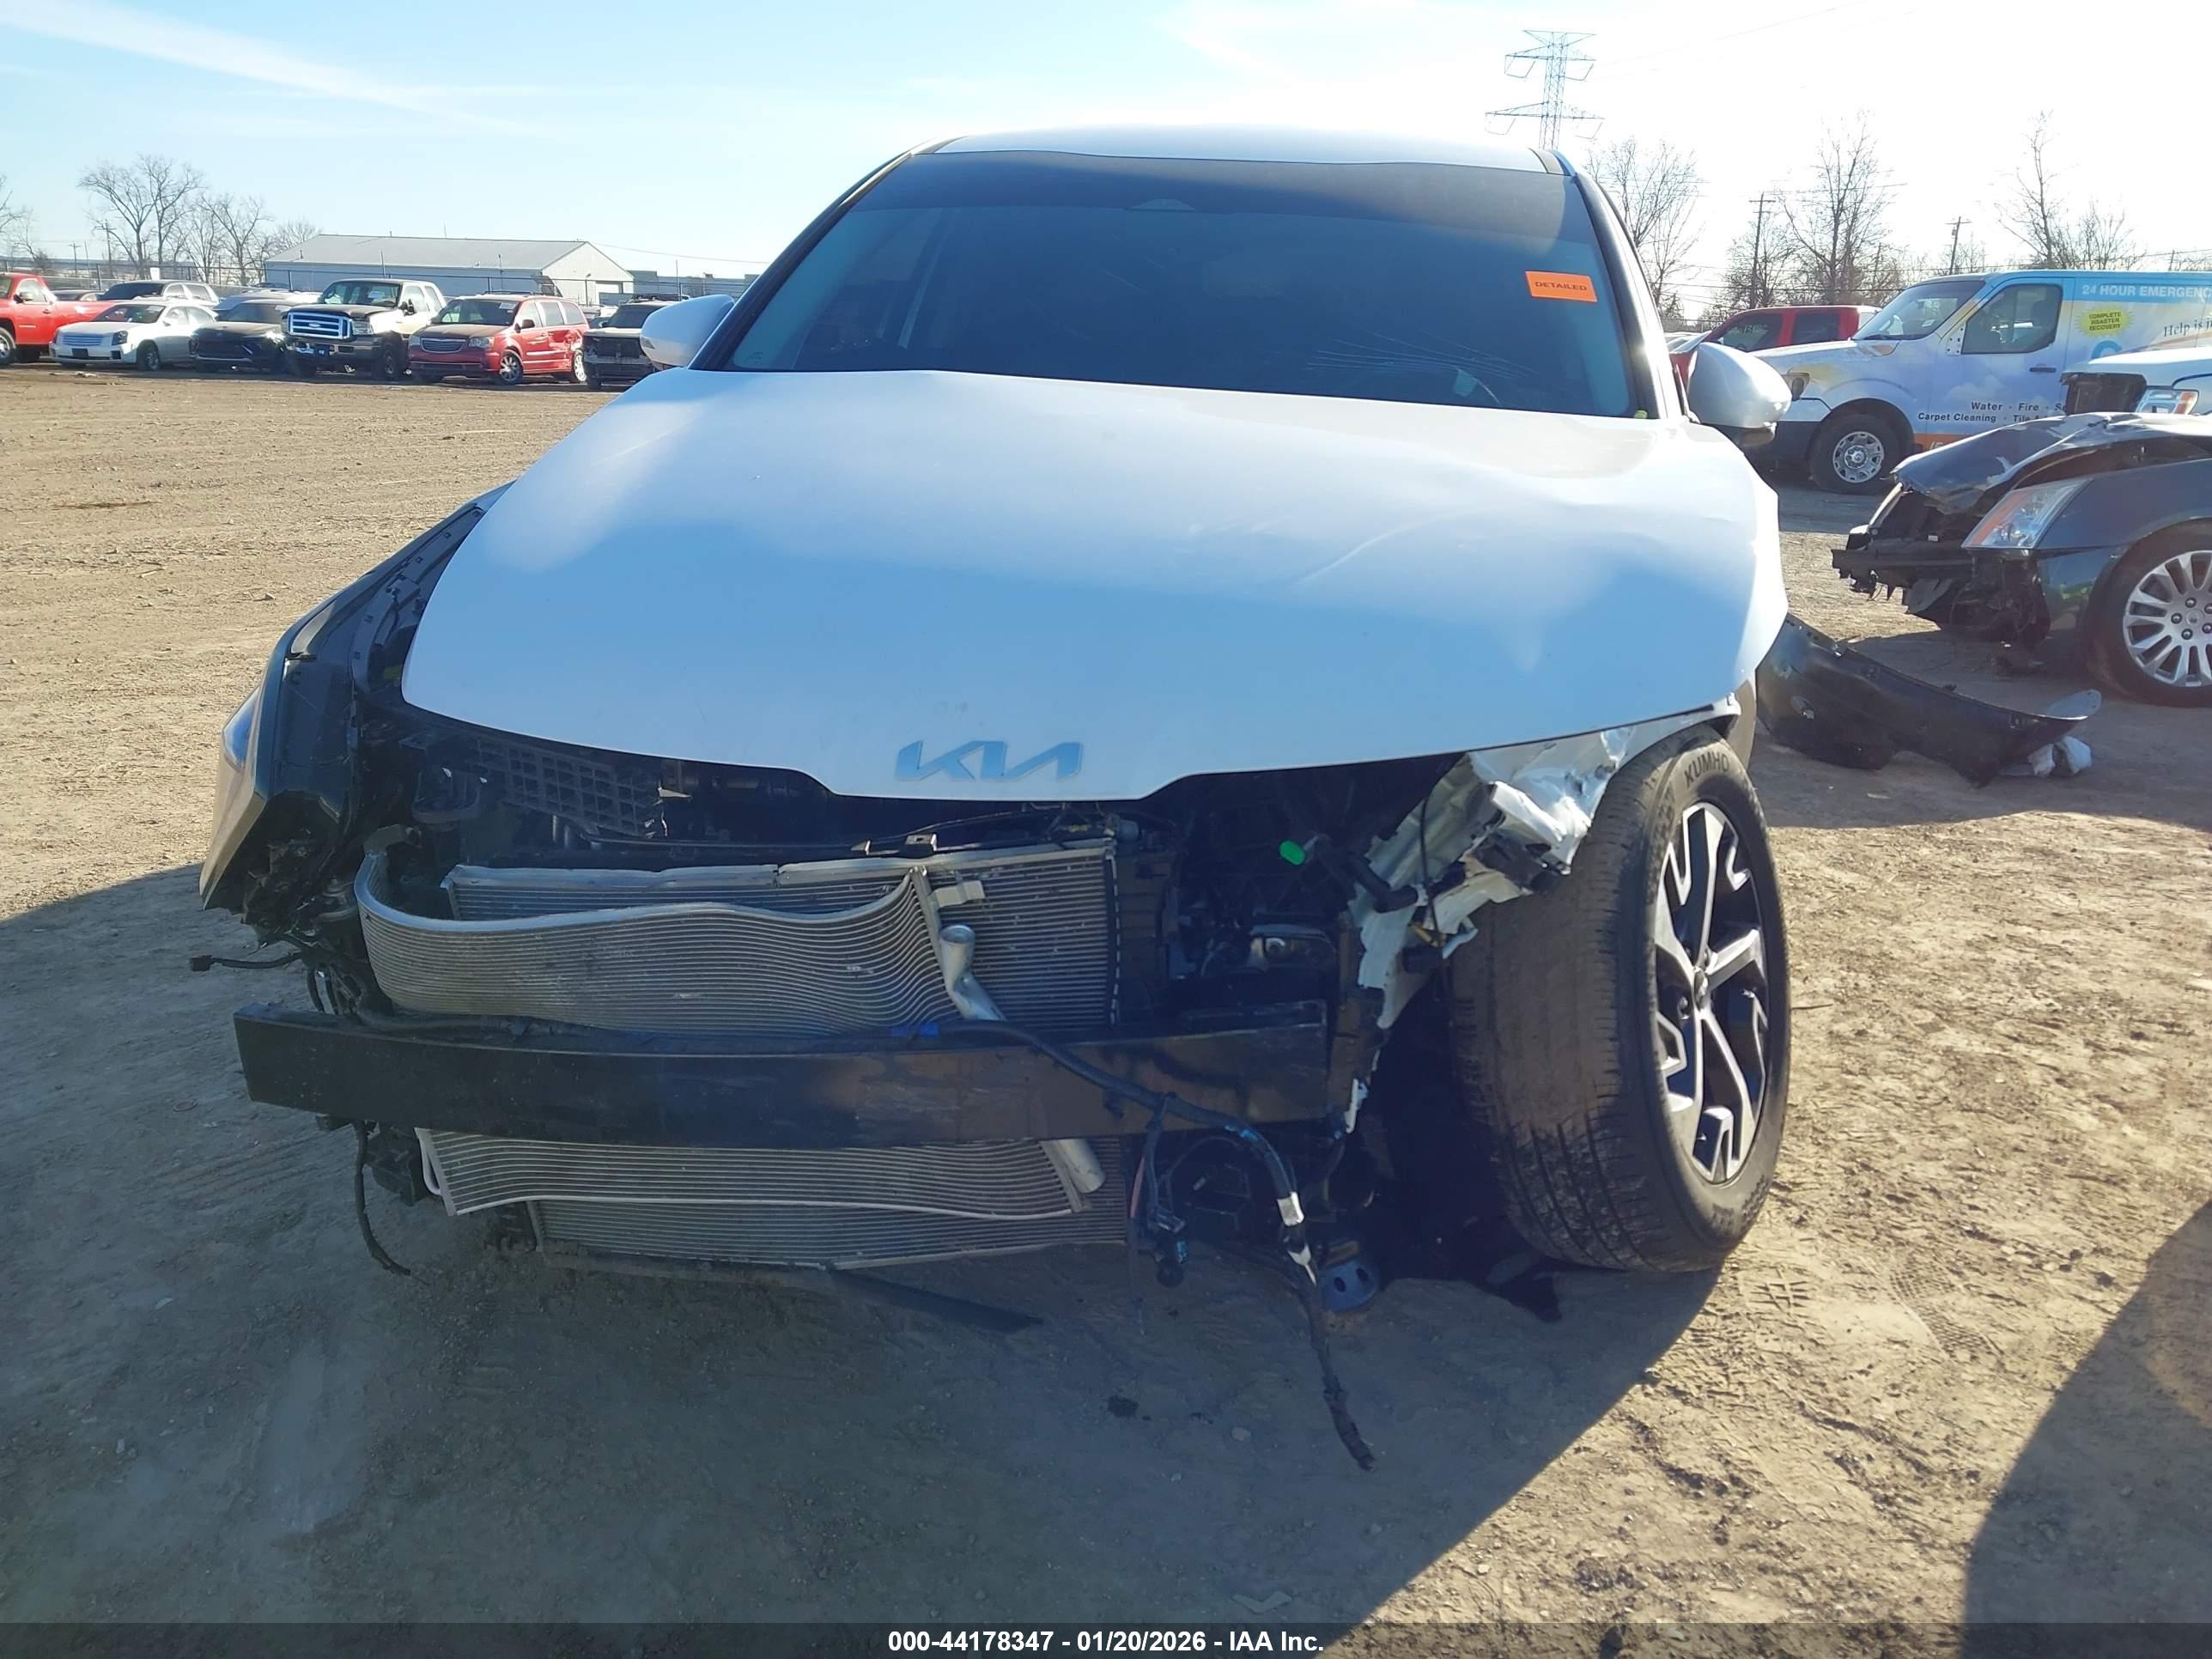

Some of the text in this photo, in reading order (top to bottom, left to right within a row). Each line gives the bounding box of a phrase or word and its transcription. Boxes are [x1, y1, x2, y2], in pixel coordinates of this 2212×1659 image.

[1534, 281, 1588, 291] DETAILED
[2082, 284, 2097, 295] 24
[2100, 284, 2136, 296] HOUR
[2164, 322, 2190, 337] Help
[2194, 319, 2203, 328] is
[1971, 402, 2003, 411] Water
[2018, 403, 2039, 411] Fire
[1917, 412, 1950, 422] Carpet
[1954, 413, 1996, 422] Cleaning
[895, 740, 1083, 781] KIA
[1684, 751, 1729, 787] KUMHO
